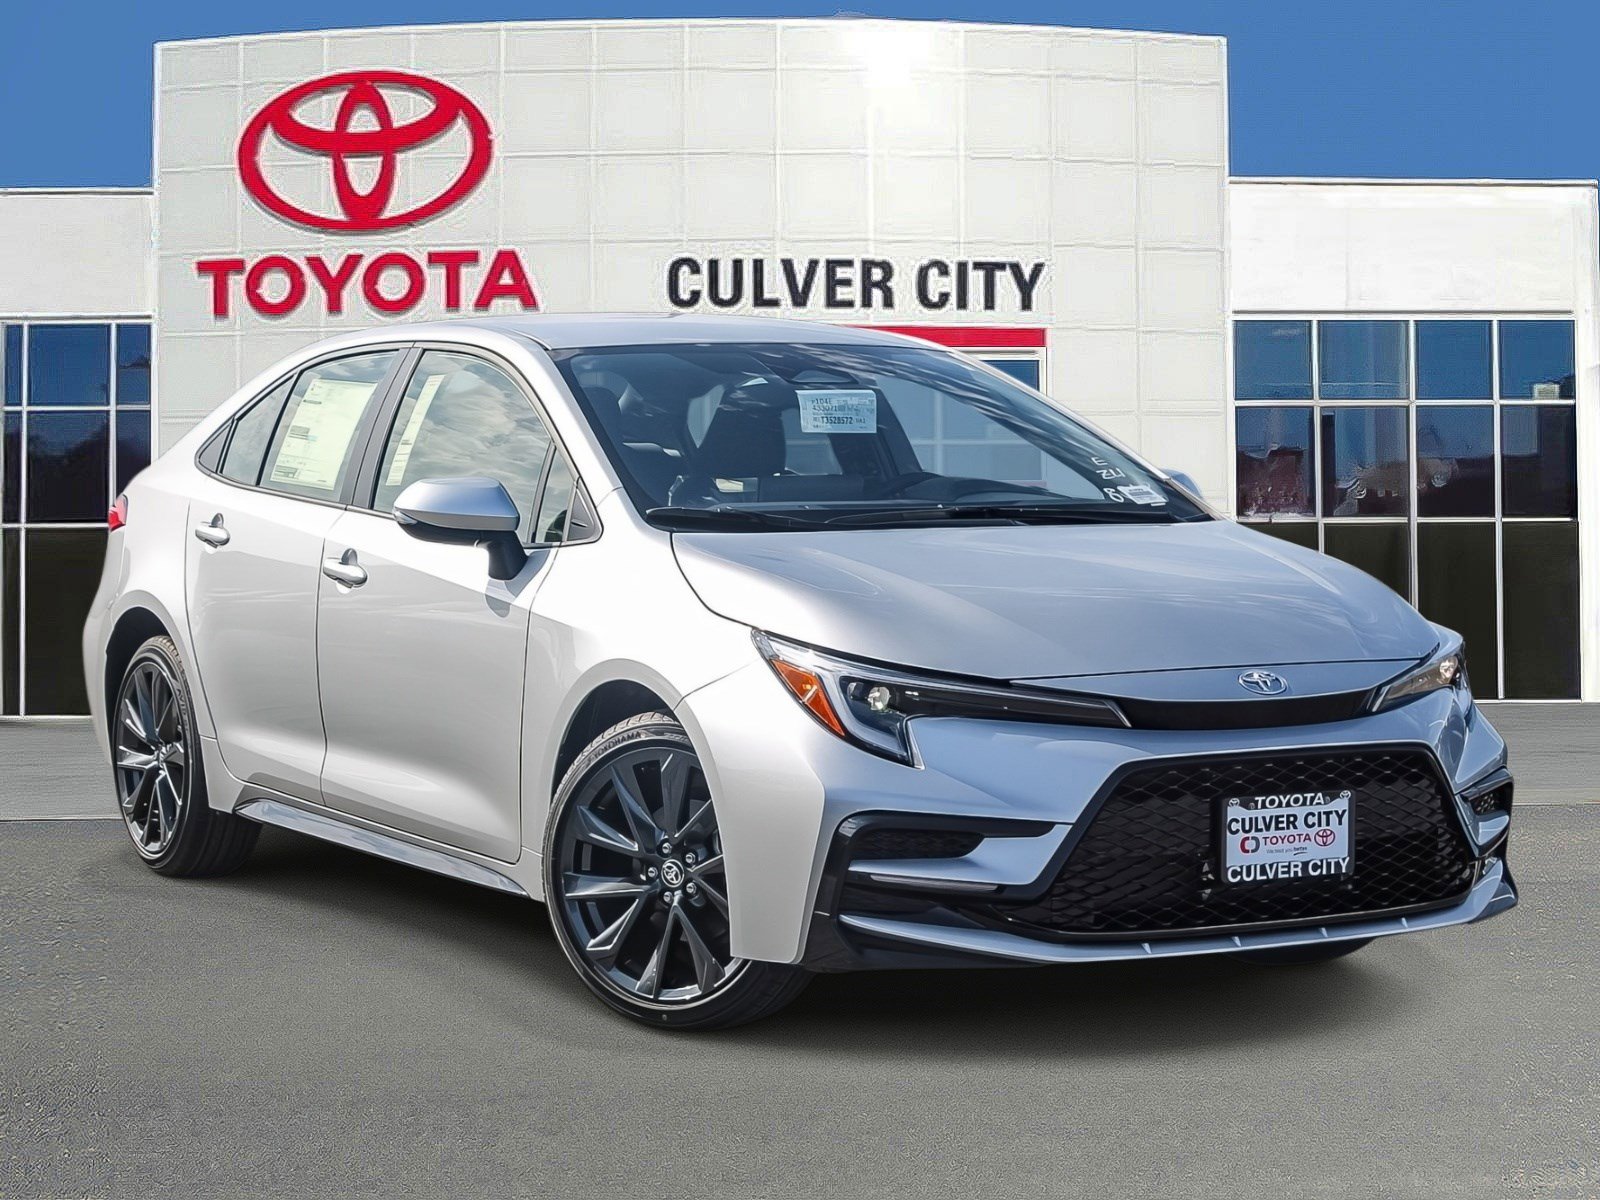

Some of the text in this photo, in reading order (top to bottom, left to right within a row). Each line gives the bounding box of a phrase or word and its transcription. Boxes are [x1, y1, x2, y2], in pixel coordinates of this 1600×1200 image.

[195, 249, 538, 318] TOYOTA
[668, 257, 1045, 311] CULVER CITY
[594, 732, 642, 758] YOKOHAMA
[1255, 793, 1325, 809] TOYOTA
[1227, 809, 1347, 835] CULVER CITY
[1262, 833, 1312, 846] TOYOTA
[1227, 856, 1350, 883] CULVER CITY
